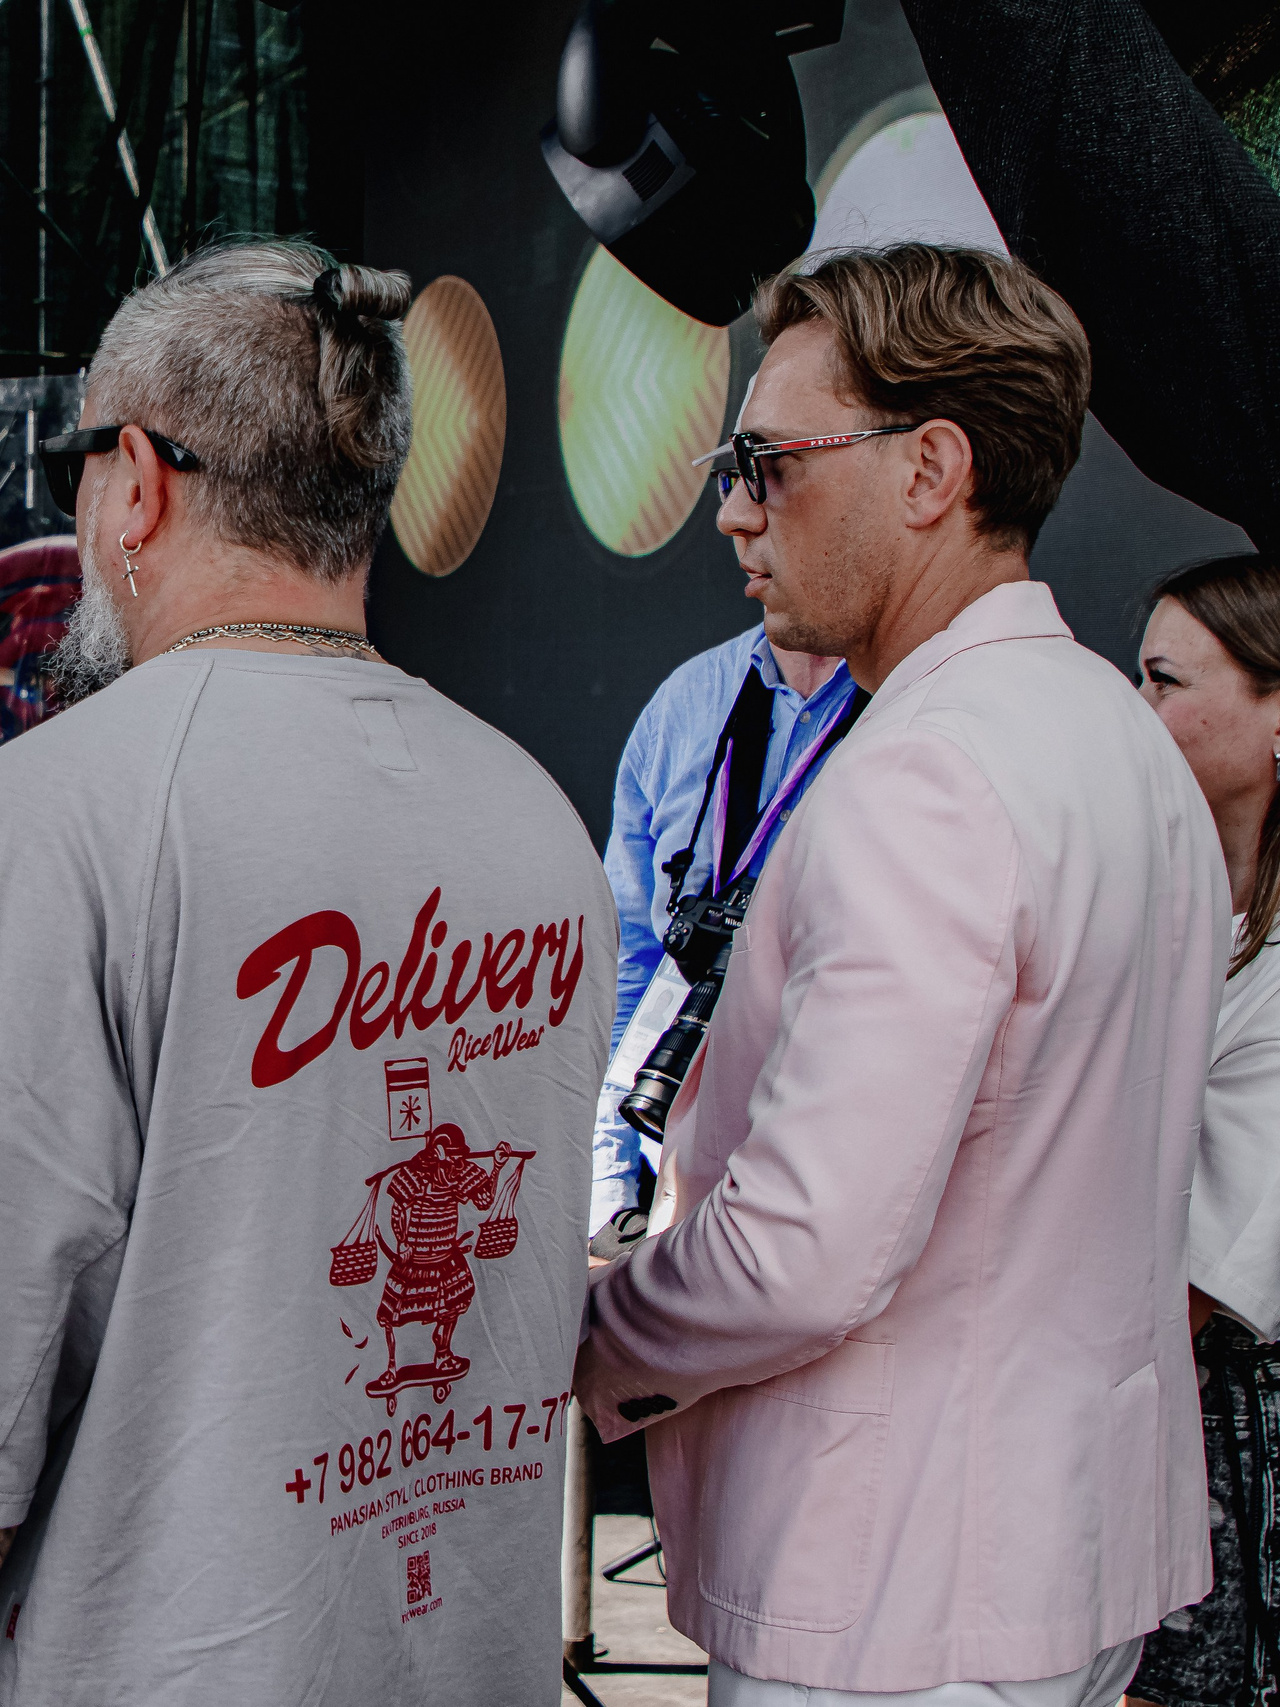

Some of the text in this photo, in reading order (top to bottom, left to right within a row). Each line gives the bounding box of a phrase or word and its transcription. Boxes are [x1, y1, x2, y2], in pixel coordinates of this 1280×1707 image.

[811, 437, 847, 446] PRADA
[237, 886, 584, 1088] Delivery
[447, 1017, 545, 1072] Rice Wear
[285, 1452, 329, 1504] +7
[338, 1429, 392, 1493] 982
[385, 1482, 412, 1513] STYL
[414, 1468, 485, 1498] CLOTHING
[490, 1462, 543, 1486] BRAND
[432, 1498, 466, 1516] RUSSIA
[398, 1522, 437, 1549] SINCE 2018
